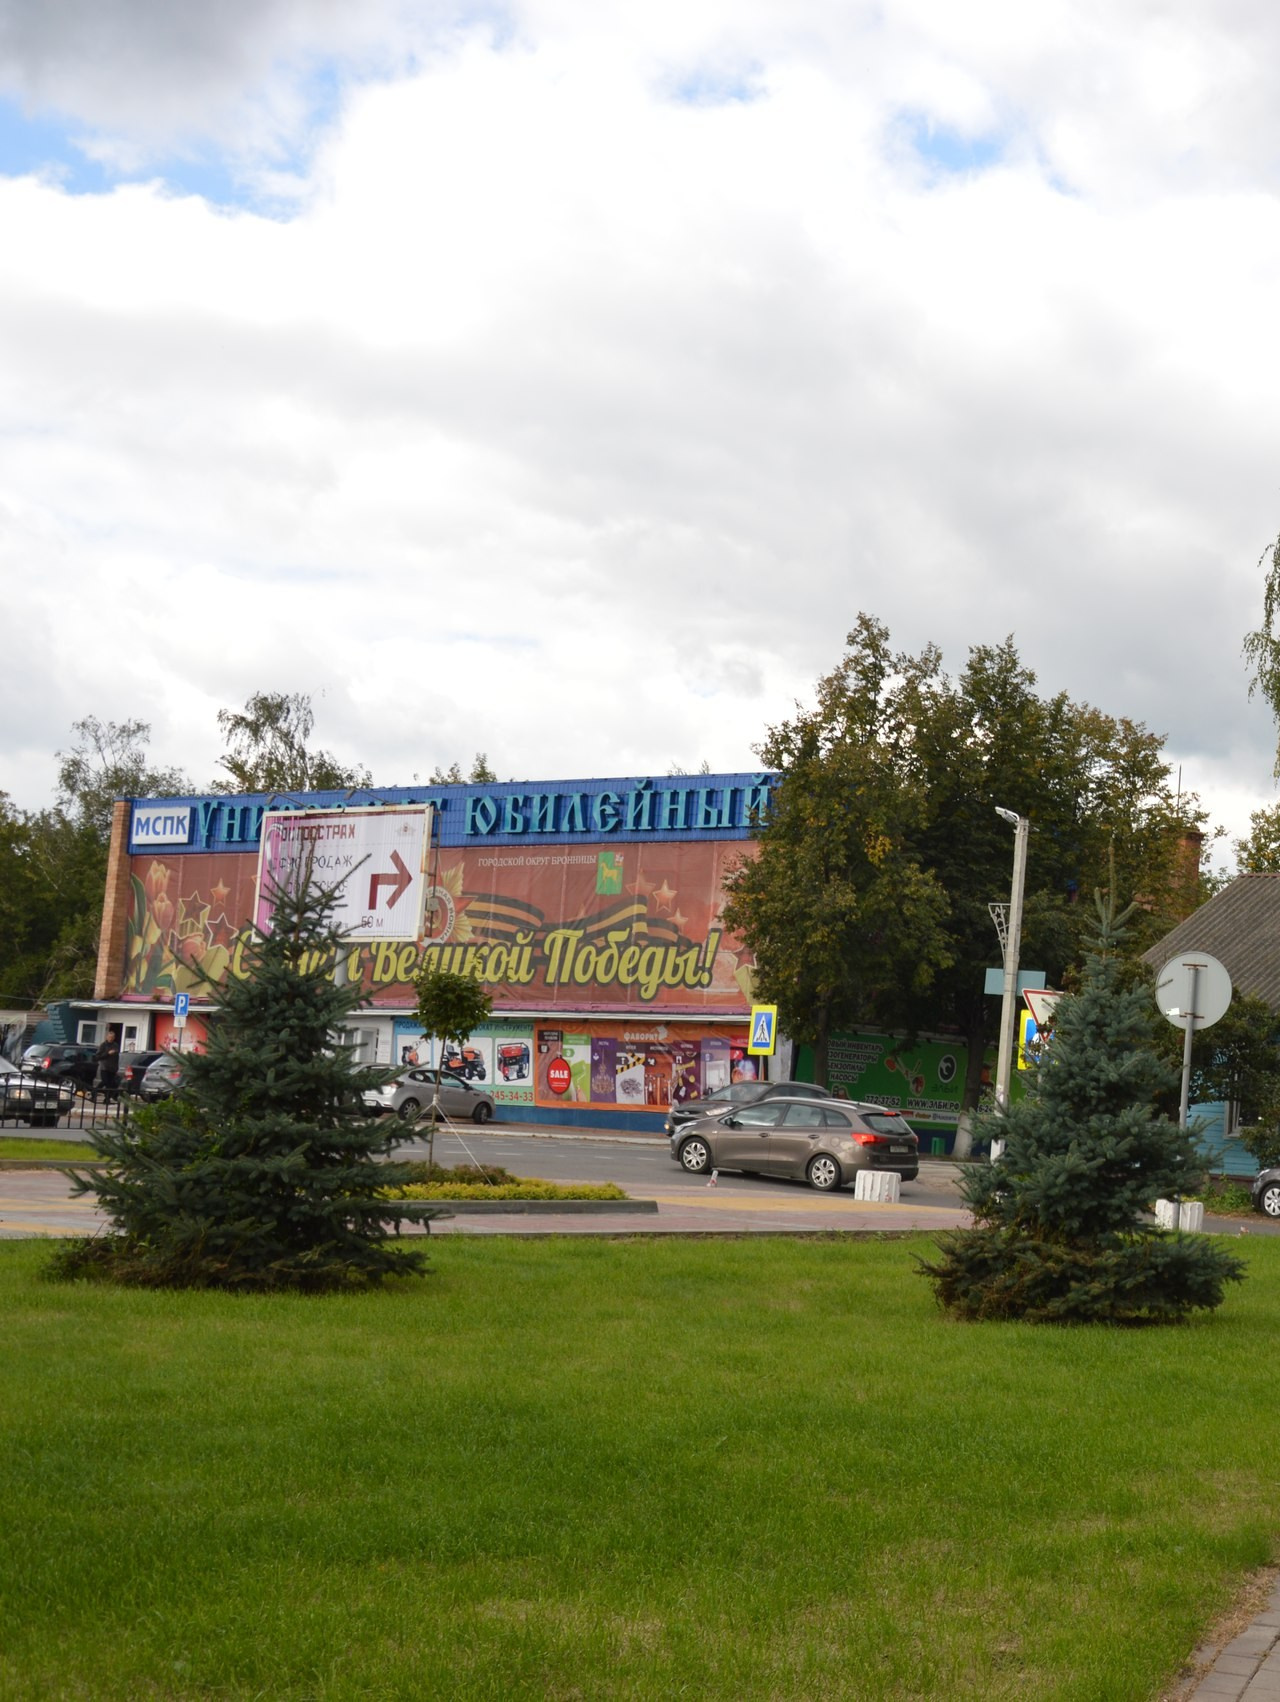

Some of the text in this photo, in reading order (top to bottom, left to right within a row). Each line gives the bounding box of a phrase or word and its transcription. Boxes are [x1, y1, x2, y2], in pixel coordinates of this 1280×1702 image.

[464, 774, 772, 835] ЮБИЛЕЙНЫЙ
[135, 815, 187, 836] МСПК
[478, 855, 597, 867] ГОРОДСКОЙ ОКРУГ БРОННИЦЫ
[361, 916, 374, 929] 50
[545, 928, 722, 999] Победы!
[827, 1051, 878, 1062] ЗОГЕНЕРАТОРЫ
[550, 1070, 569, 1079] SALE
[830, 1073, 857, 1082] НАСОСЫ
